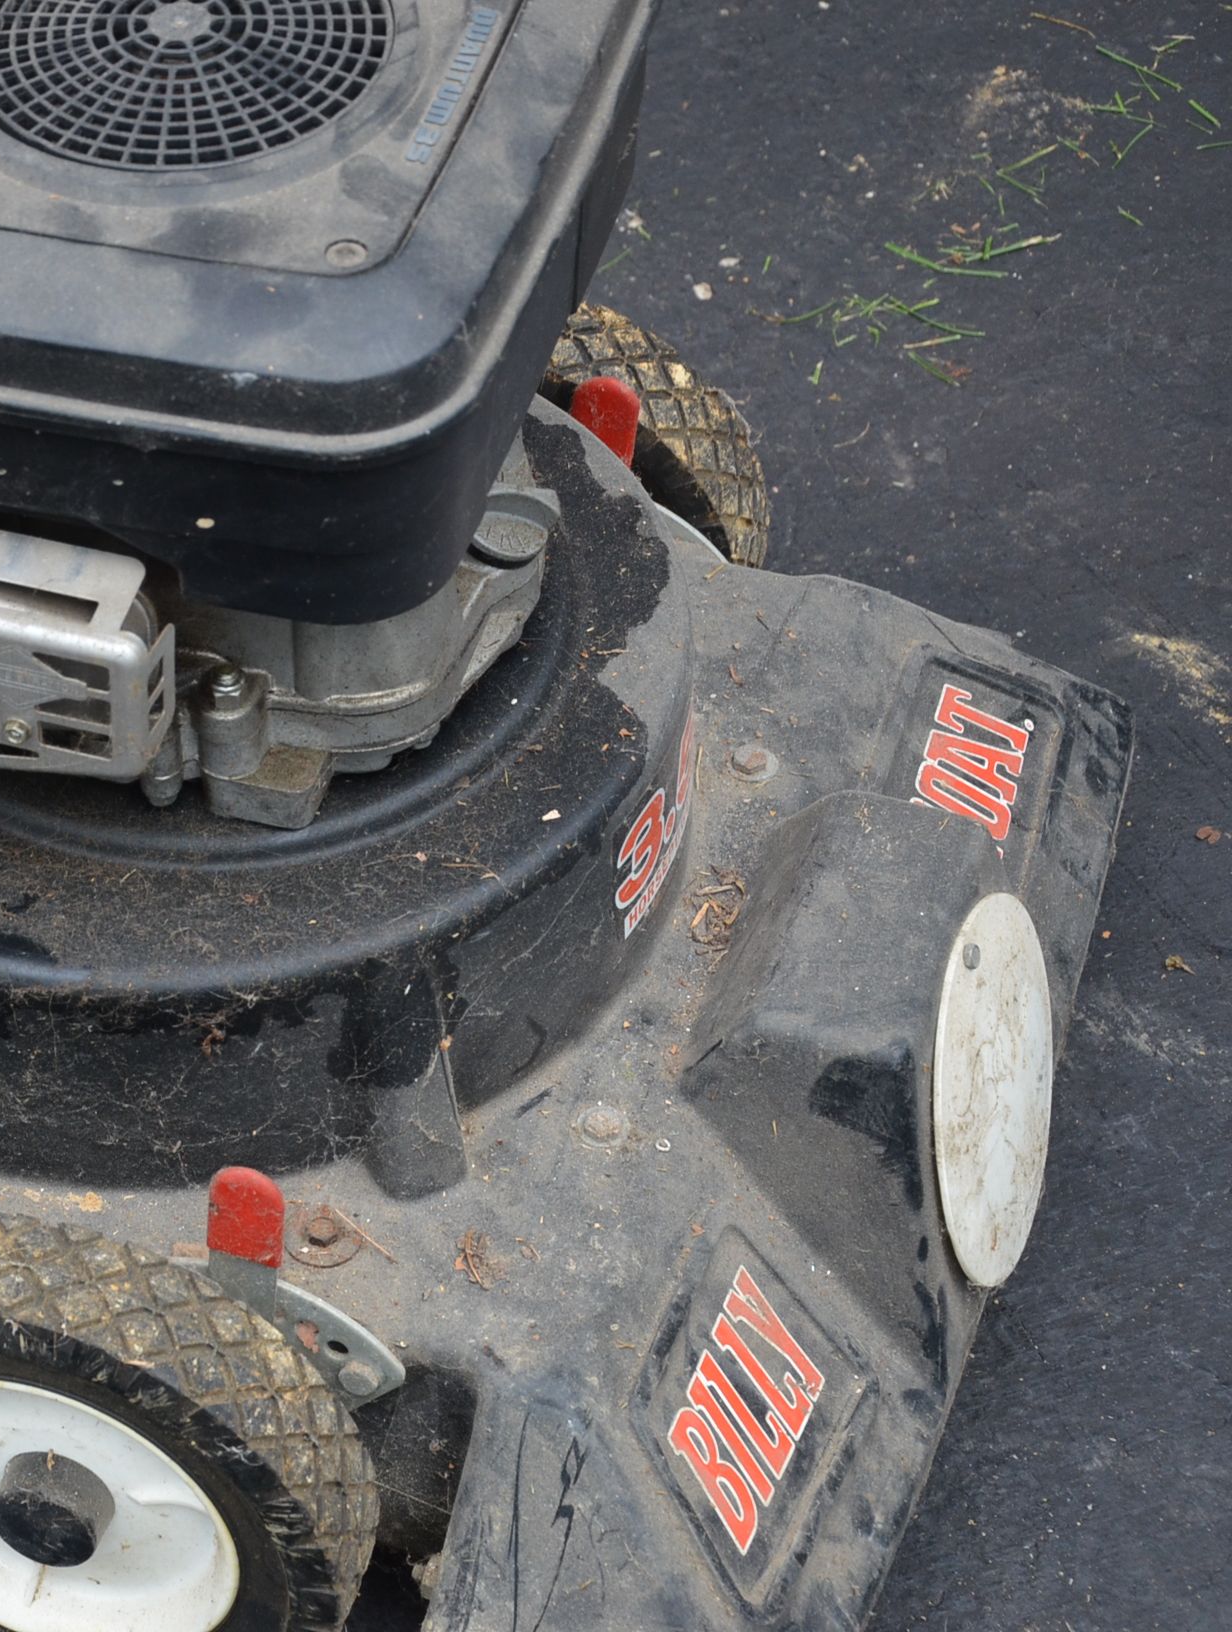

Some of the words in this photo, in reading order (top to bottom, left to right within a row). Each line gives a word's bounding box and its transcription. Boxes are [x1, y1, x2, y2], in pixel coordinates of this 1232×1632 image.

[423, 9, 498, 126] QUANTUM
[909, 683, 1029, 858] OAT
[668, 1264, 826, 1557] BILLY
